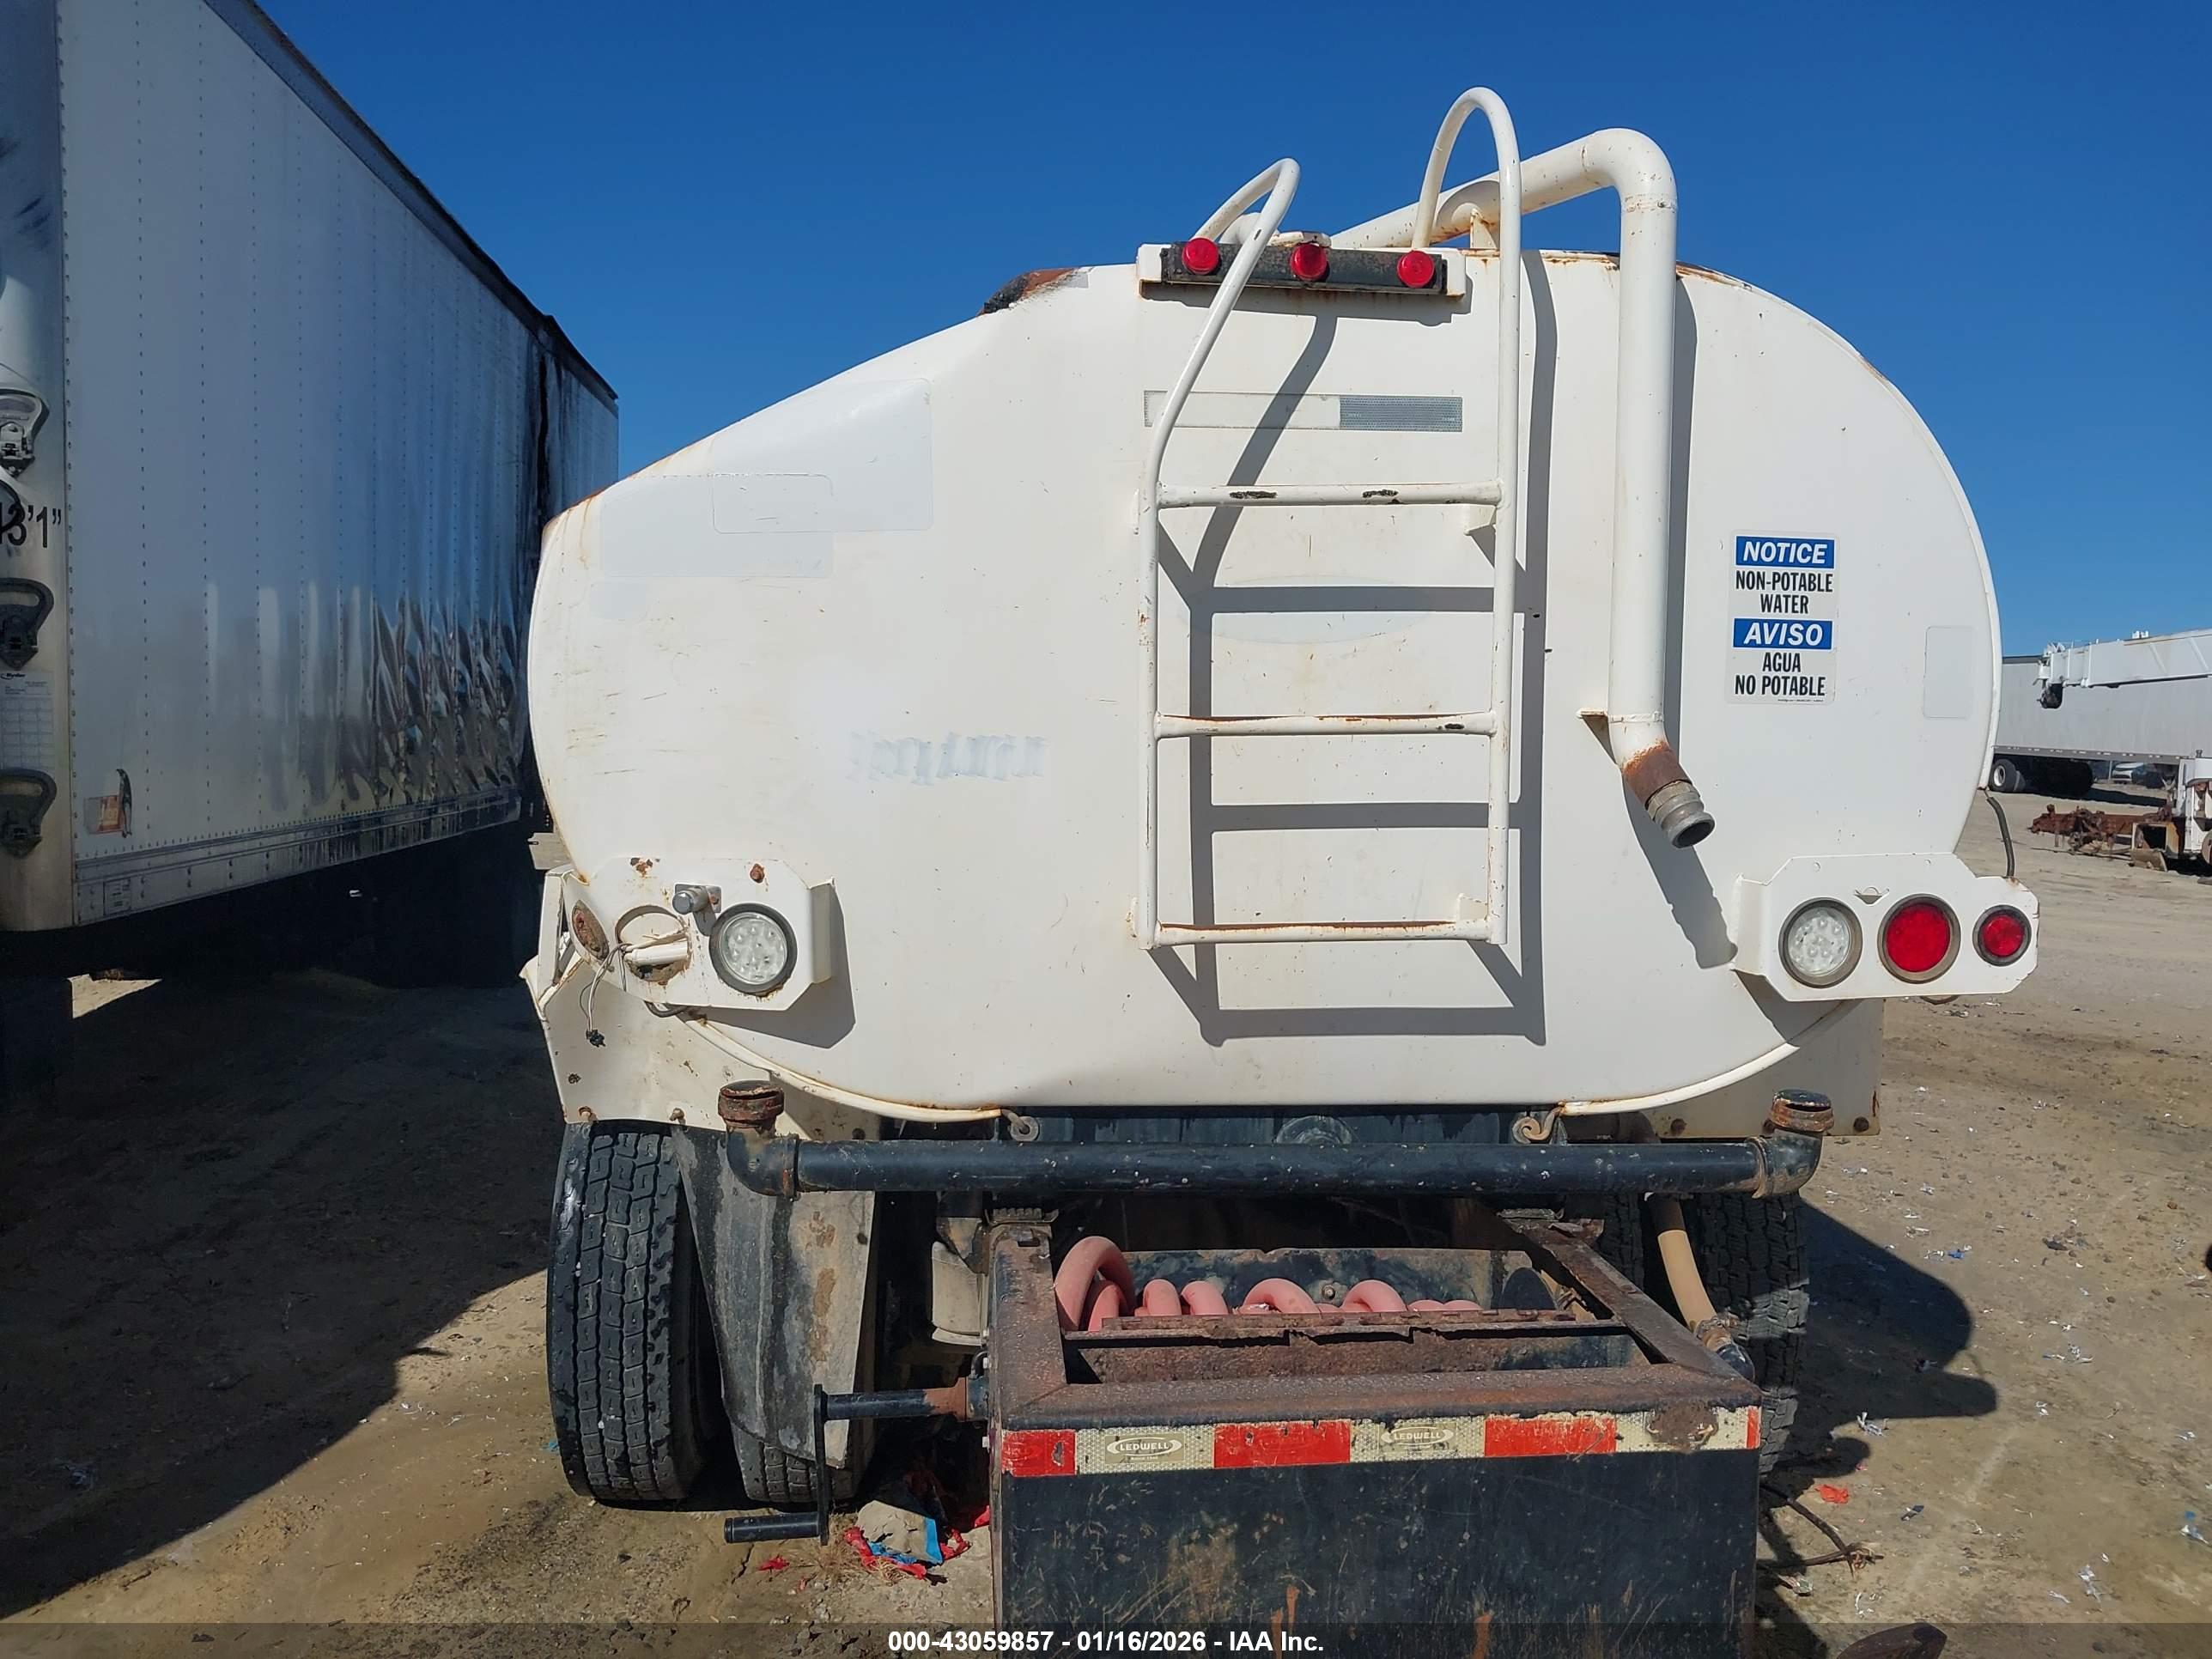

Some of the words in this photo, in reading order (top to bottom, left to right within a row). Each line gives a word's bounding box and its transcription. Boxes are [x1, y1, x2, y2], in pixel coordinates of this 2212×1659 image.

[1743, 541, 1827, 563] NOTICE
[1735, 570, 1833, 592] NON-POTABLE
[1760, 593, 1809, 614] WATER
[1743, 623, 1823, 646] AVISO
[1762, 652, 1802, 672] AGUA
[1735, 675, 1756, 696] NO
[1762, 675, 1826, 696] POTABLE
[1394, 1431, 1441, 1440] LEDWELL
[1120, 1442, 1170, 1451] LEDWELL
